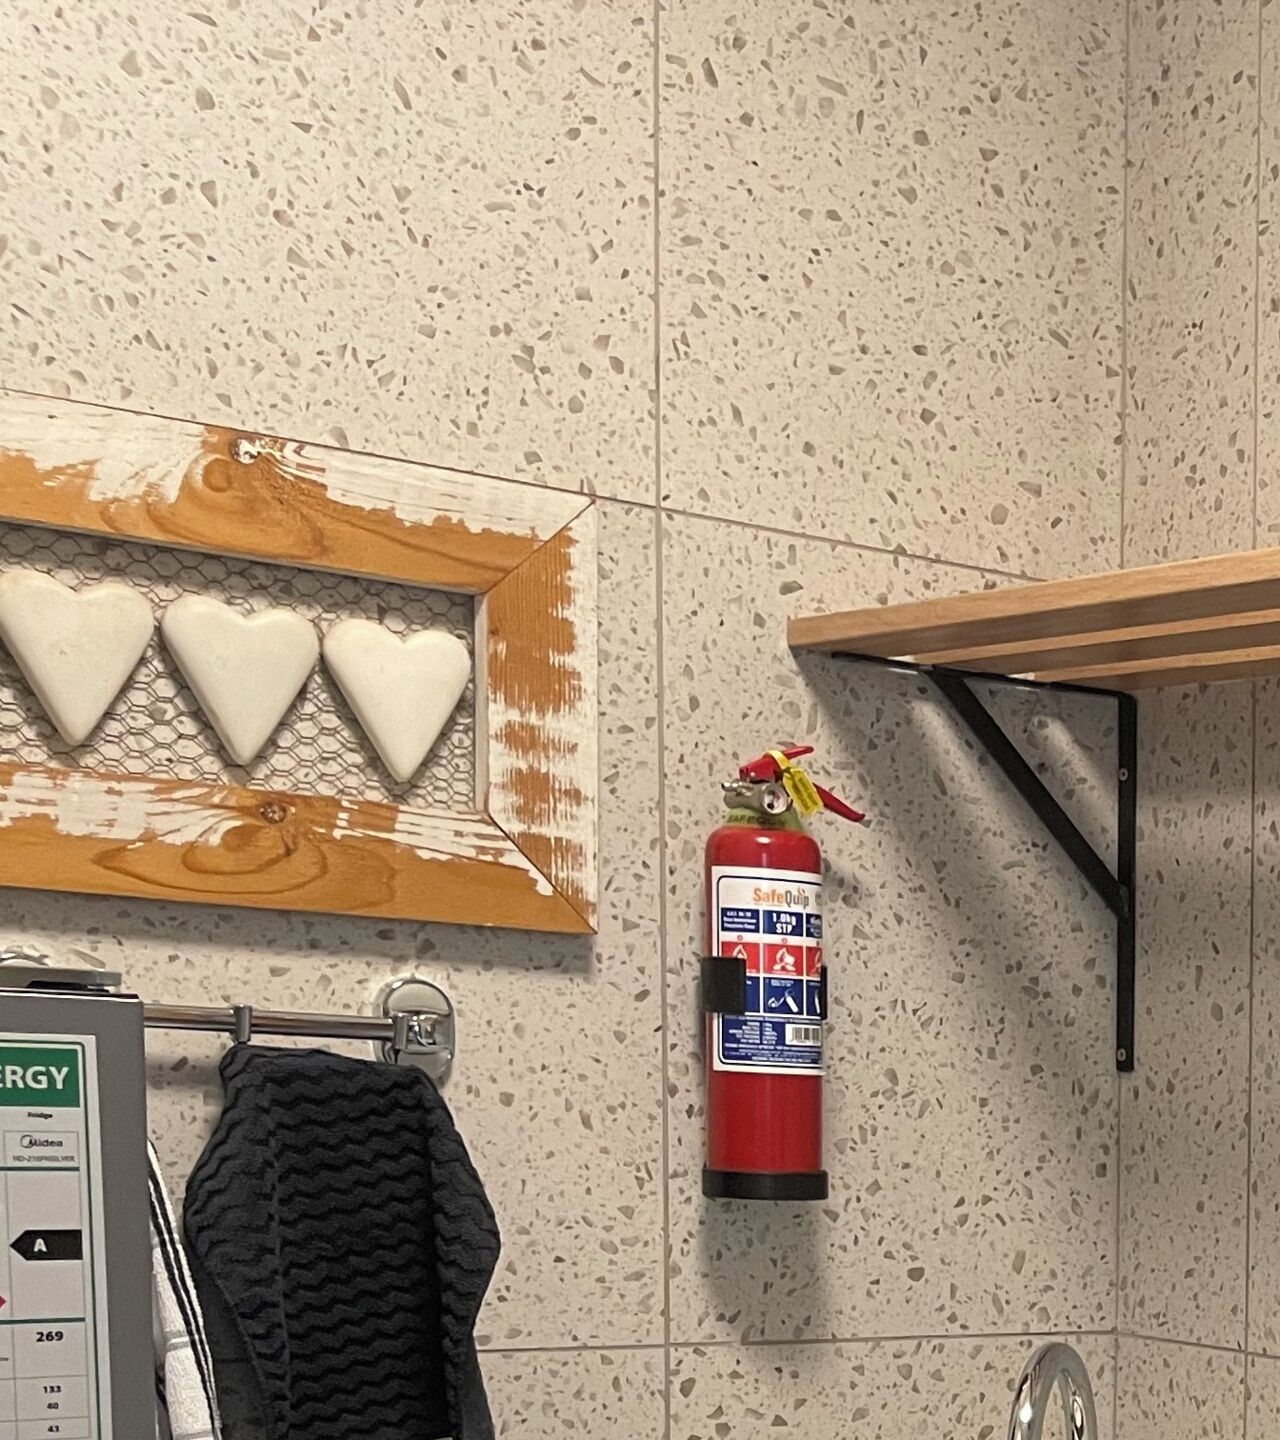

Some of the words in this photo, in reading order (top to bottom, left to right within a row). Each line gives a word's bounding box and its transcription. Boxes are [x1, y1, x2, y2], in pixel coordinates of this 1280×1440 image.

[752, 887, 810, 909] SafeQuip
[0, 1064, 69, 1090] RGY
[34, 1238, 47, 1252] A
[36, 1331, 64, 1342] 269
[43, 1385, 62, 1394] 133
